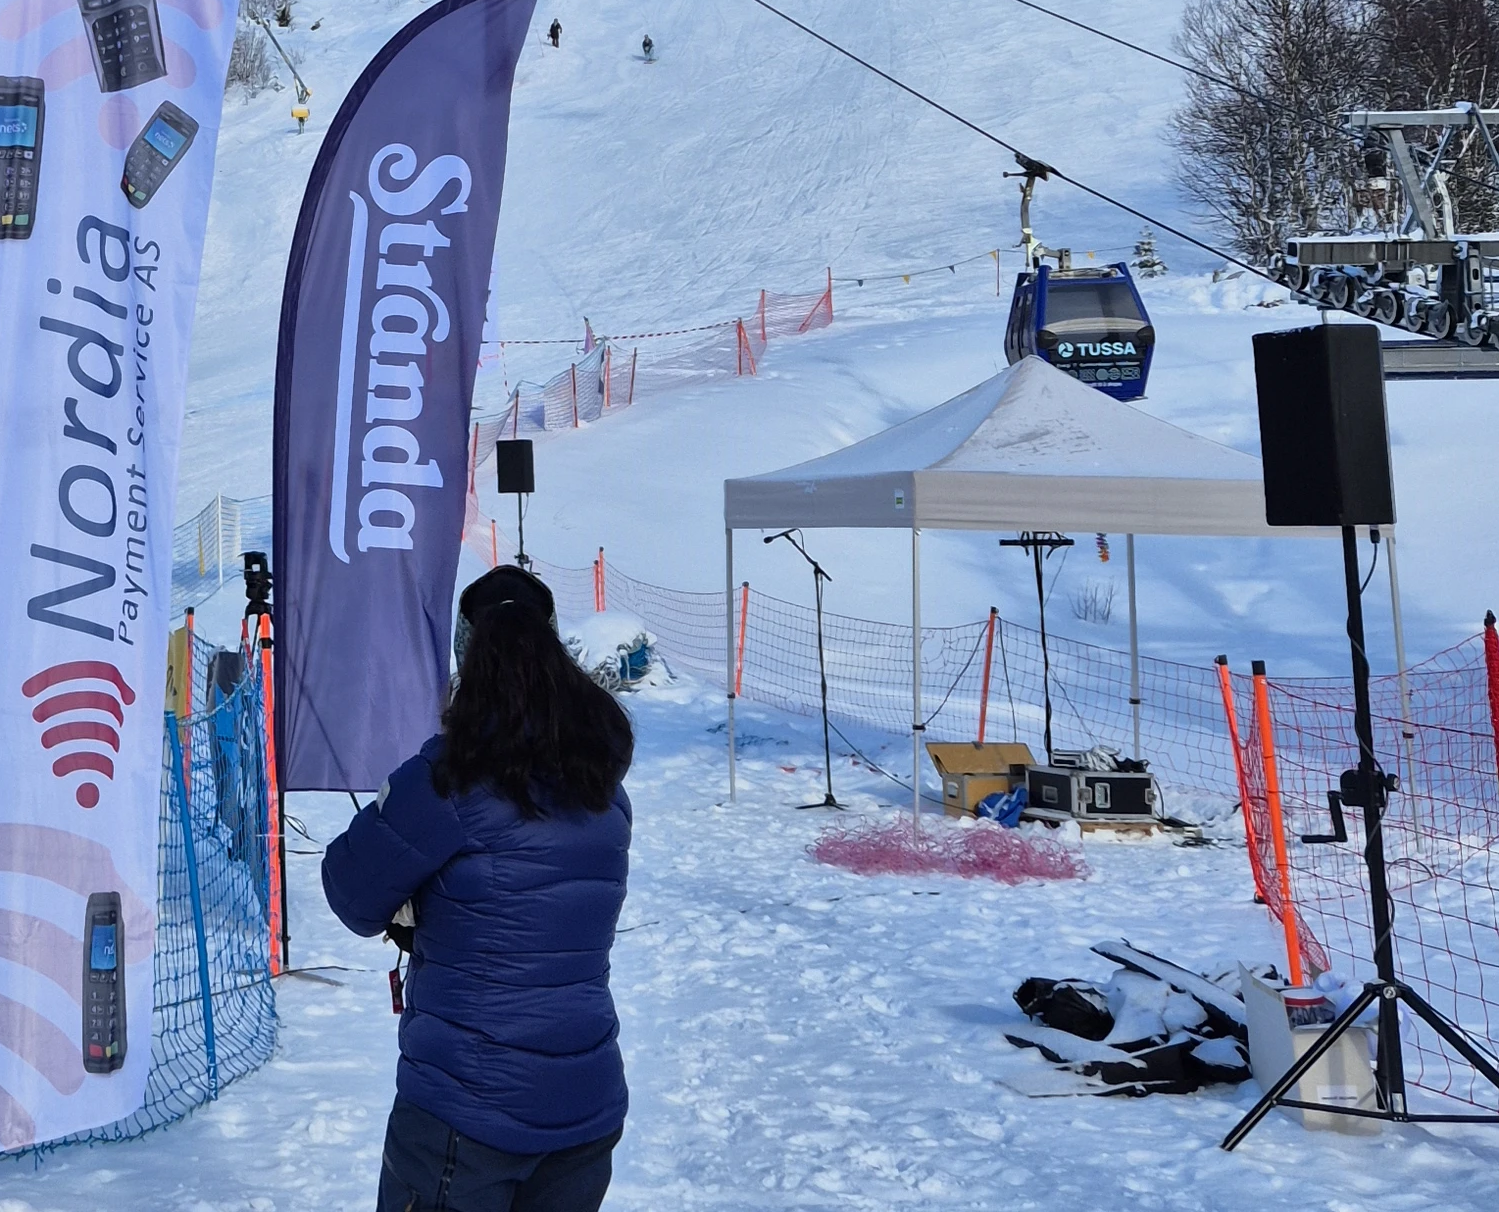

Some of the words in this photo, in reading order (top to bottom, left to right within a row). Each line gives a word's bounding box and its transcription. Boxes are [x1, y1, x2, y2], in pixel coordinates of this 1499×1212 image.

[0, 123, 21, 134] nets
[134, 236, 160, 291] AS
[127, 304, 154, 446] Service
[358, 143, 472, 552] Stranda
[1076, 342, 1136, 356] TUSSA
[27, 215, 130, 642] Nordia
[118, 464, 149, 645] Payment
